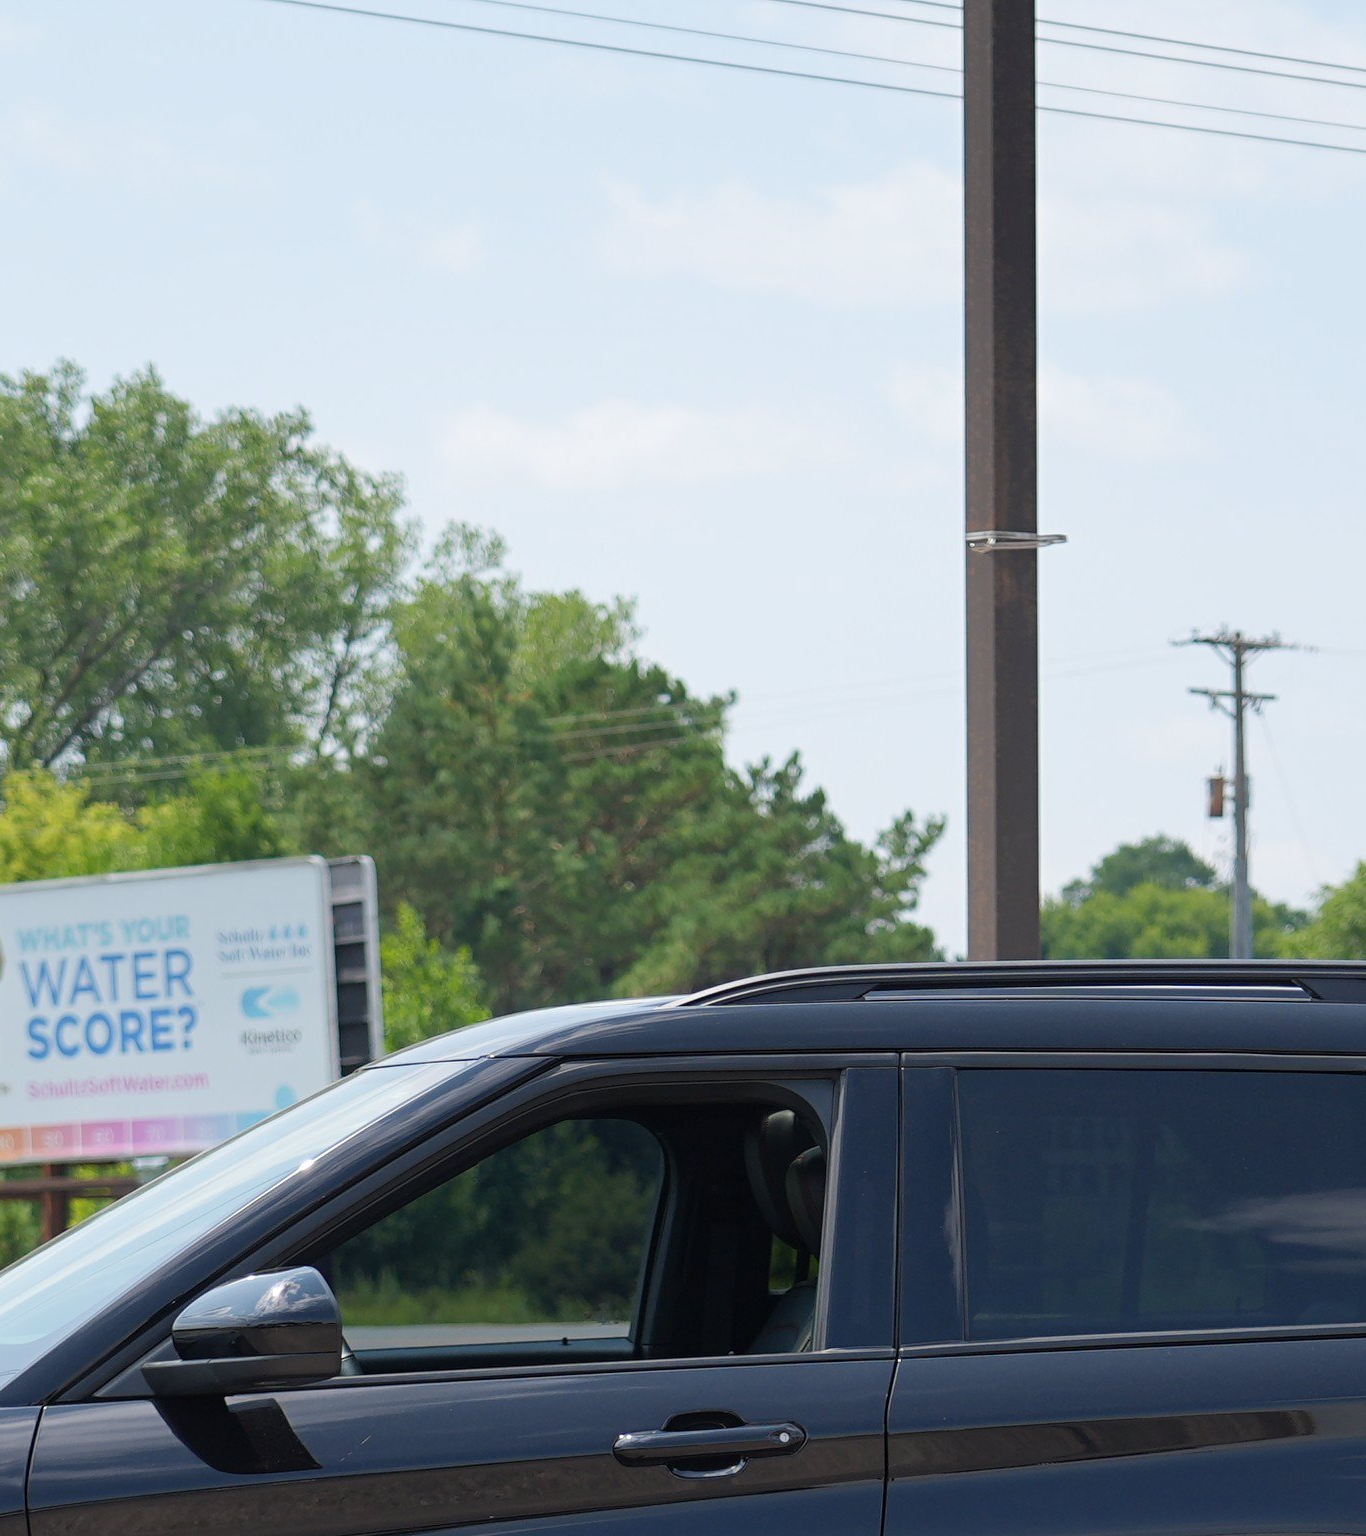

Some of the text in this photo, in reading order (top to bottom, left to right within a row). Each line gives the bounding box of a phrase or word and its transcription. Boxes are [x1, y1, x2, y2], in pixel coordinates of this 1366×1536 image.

[16, 914, 191, 952] WHAT'S YOUR
[249, 943, 287, 960] Water
[19, 946, 195, 1009] WATER
[26, 1003, 199, 1060] SCORE?
[241, 1027, 303, 1046] Kinetico
[28, 1071, 210, 1101] SchultzSoftWater.com
